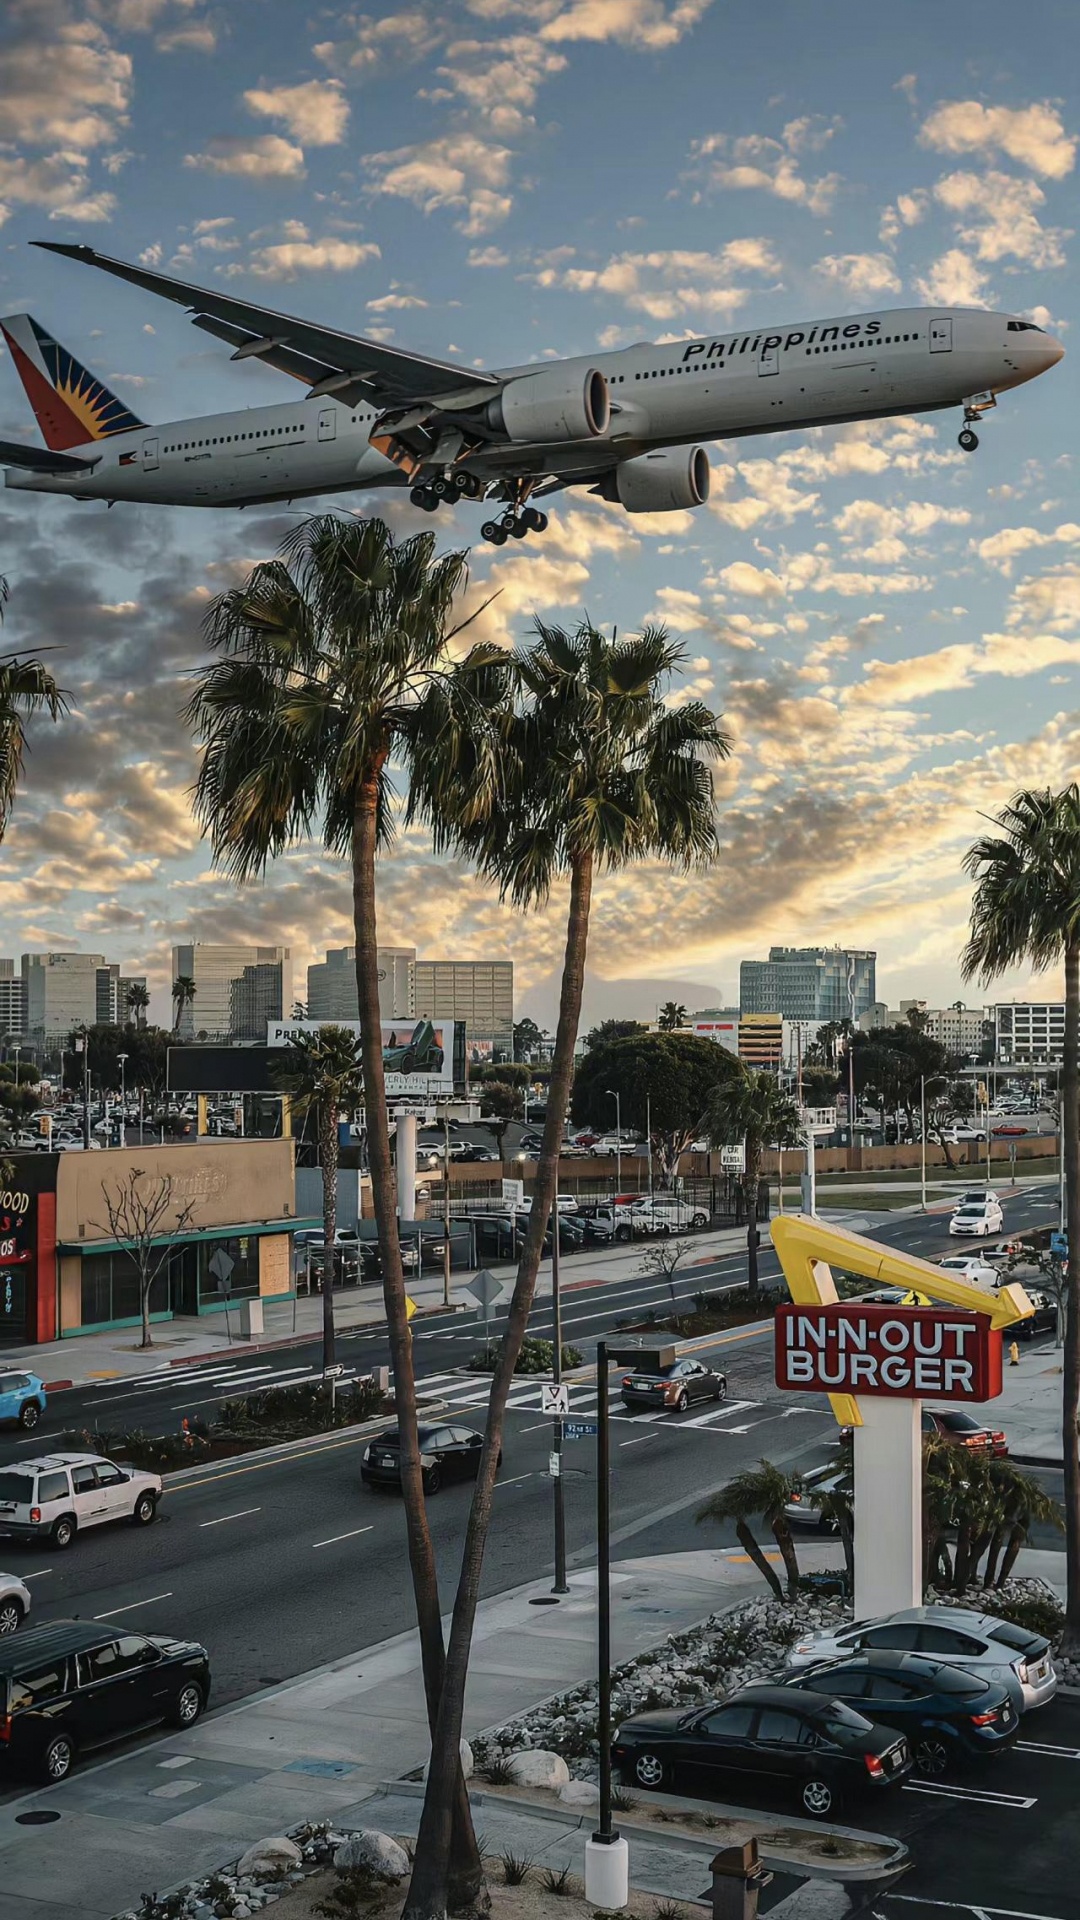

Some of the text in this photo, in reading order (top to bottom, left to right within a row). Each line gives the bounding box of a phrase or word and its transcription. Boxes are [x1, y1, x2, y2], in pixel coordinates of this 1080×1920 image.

[682, 321, 881, 362] Philippines
[786, 1315, 976, 1356] IN-N-OUT
[786, 1350, 974, 1392] BURGER
